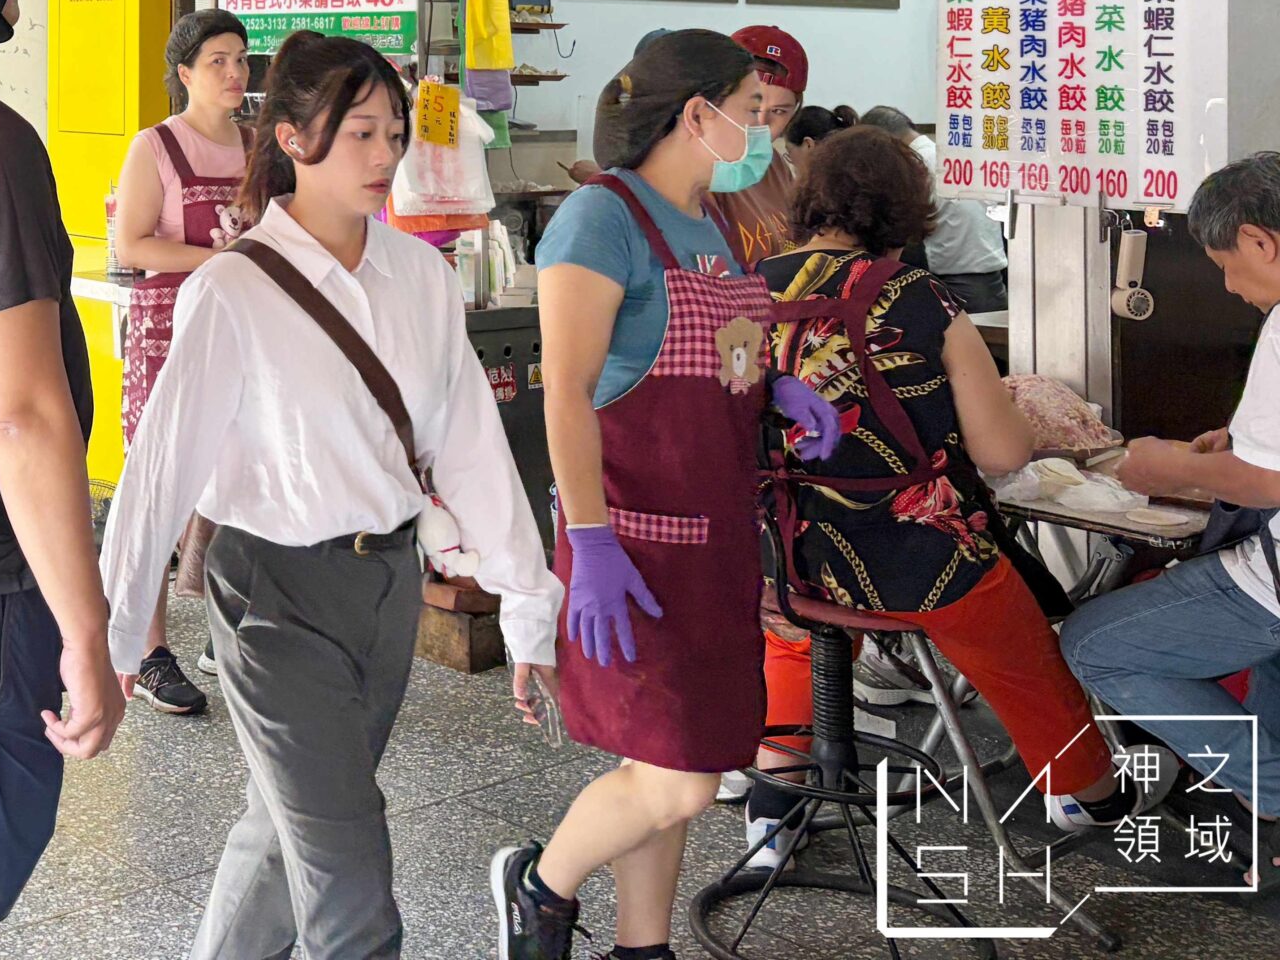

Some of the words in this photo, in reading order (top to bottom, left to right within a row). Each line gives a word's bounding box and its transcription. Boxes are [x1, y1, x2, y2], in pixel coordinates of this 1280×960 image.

[943, 158, 974, 187] 200
[980, 161, 1010, 189] 160
[1018, 163, 1049, 191] 160
[1058, 165, 1091, 195] 200
[1095, 168, 1128, 199] 160
[1143, 169, 1179, 200] 200
